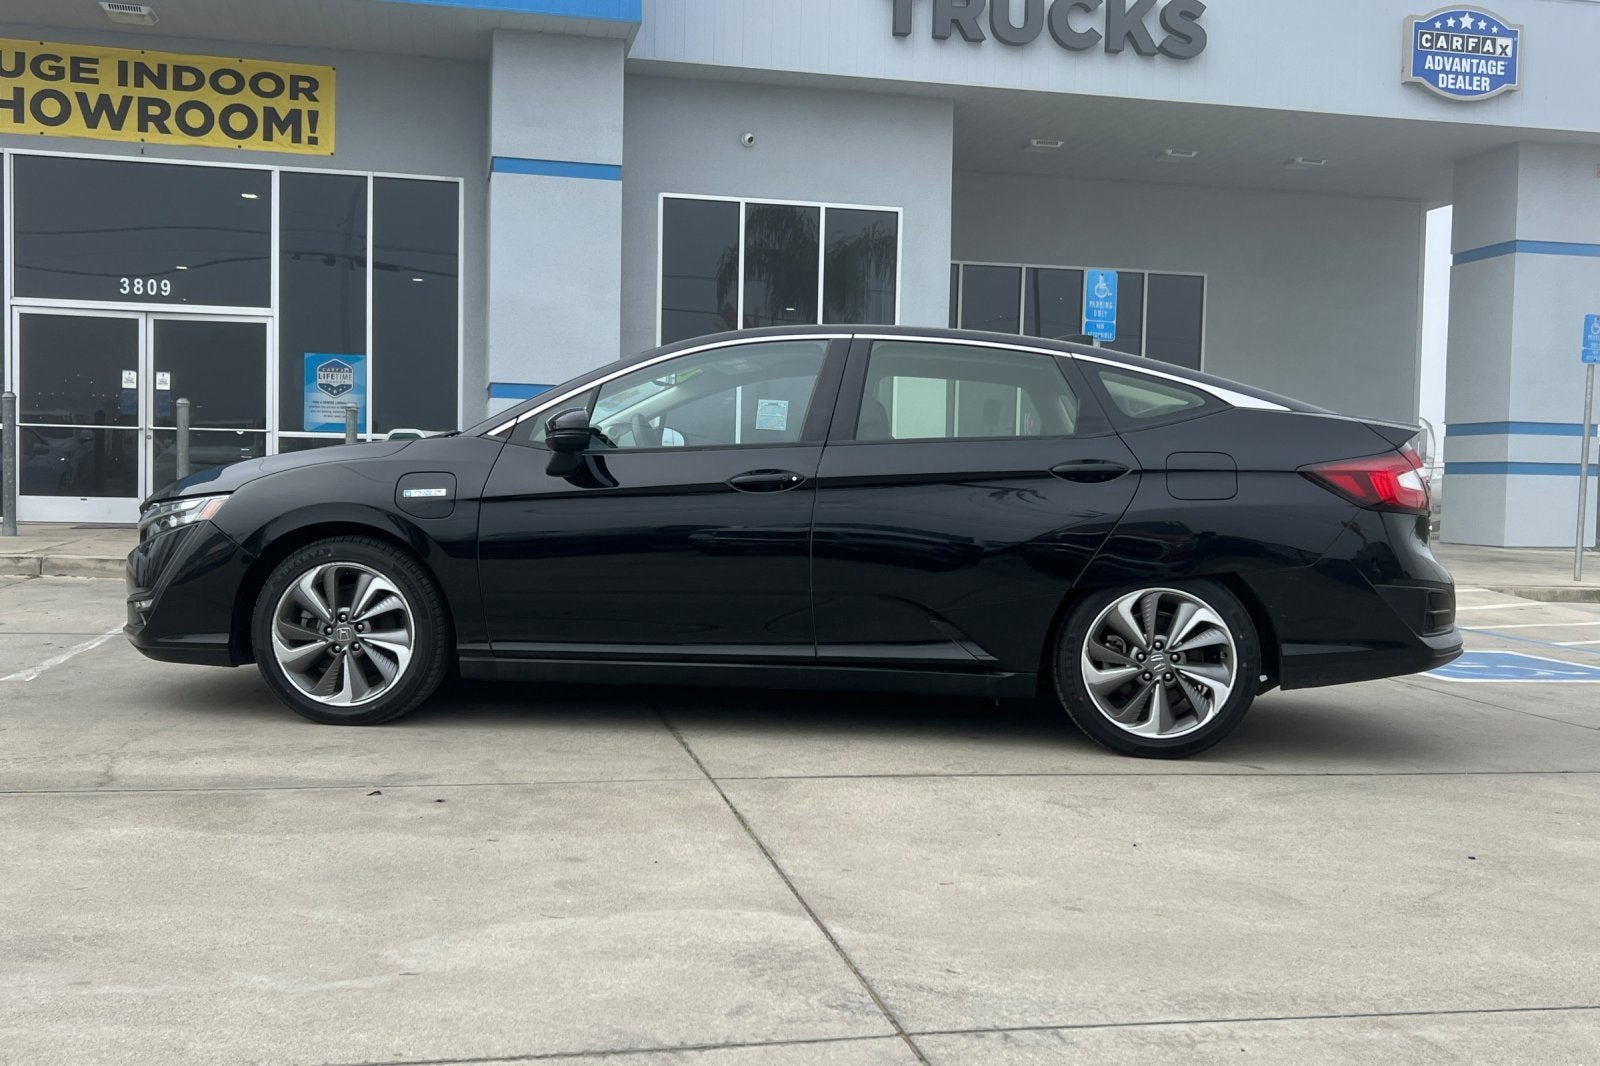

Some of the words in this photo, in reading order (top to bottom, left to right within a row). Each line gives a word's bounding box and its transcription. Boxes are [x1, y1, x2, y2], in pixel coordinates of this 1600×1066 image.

[886, 0, 1207, 59] TRUCKS
[1420, 33, 1510, 57] CARFAX
[1424, 55, 1505, 76] ADVANTAGE
[117, 60, 320, 102] INDOOR
[1438, 73, 1491, 92] DEALER
[119, 277, 171, 296] 3809
[1089, 301, 1113, 309] PARKING
